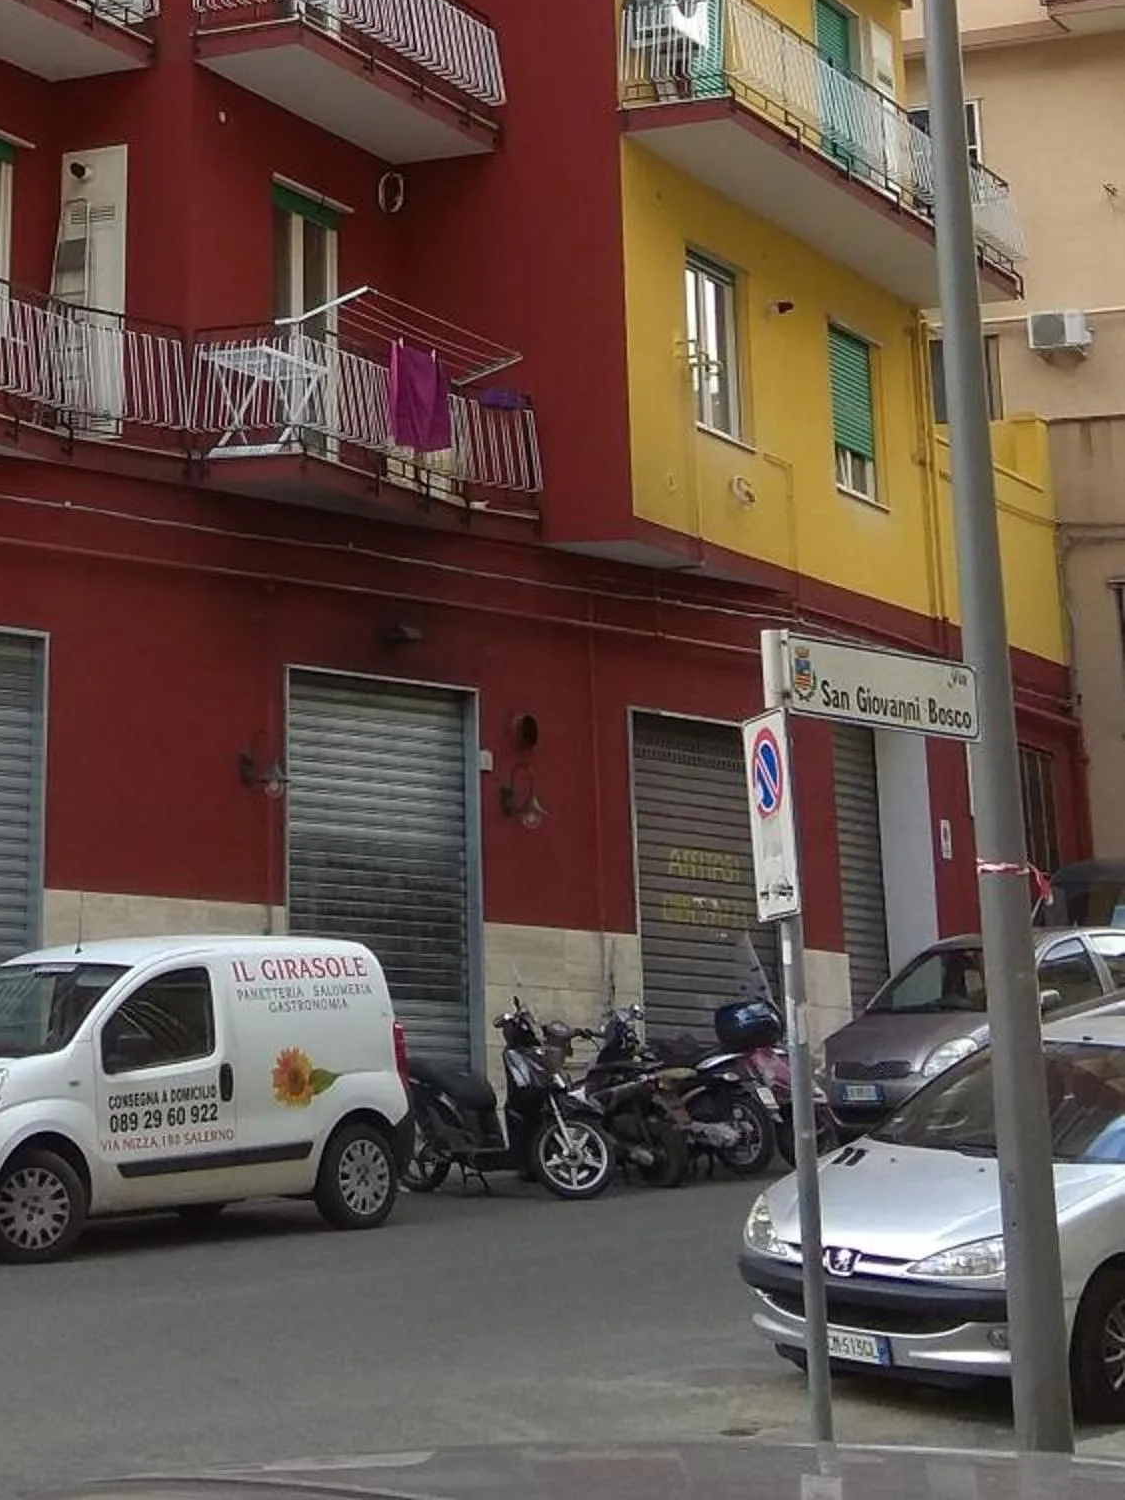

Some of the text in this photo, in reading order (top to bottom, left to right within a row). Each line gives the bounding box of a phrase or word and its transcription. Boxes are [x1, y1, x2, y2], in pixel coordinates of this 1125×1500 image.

[821, 680, 971, 729] San Giovanni Bosco
[232, 957, 368, 982] IL GIRASOLE
[236, 984, 372, 1001] PANETTERIA SALUMERIA
[268, 998, 349, 1013] GASTRONOMIA
[108, 1084, 217, 1110] CONSEGNA A DOMICILIO
[110, 1103, 218, 1133] 089 29 60 922
[101, 1138, 120, 1152] VIA
[183, 1128, 235, 1146] SALERNO
